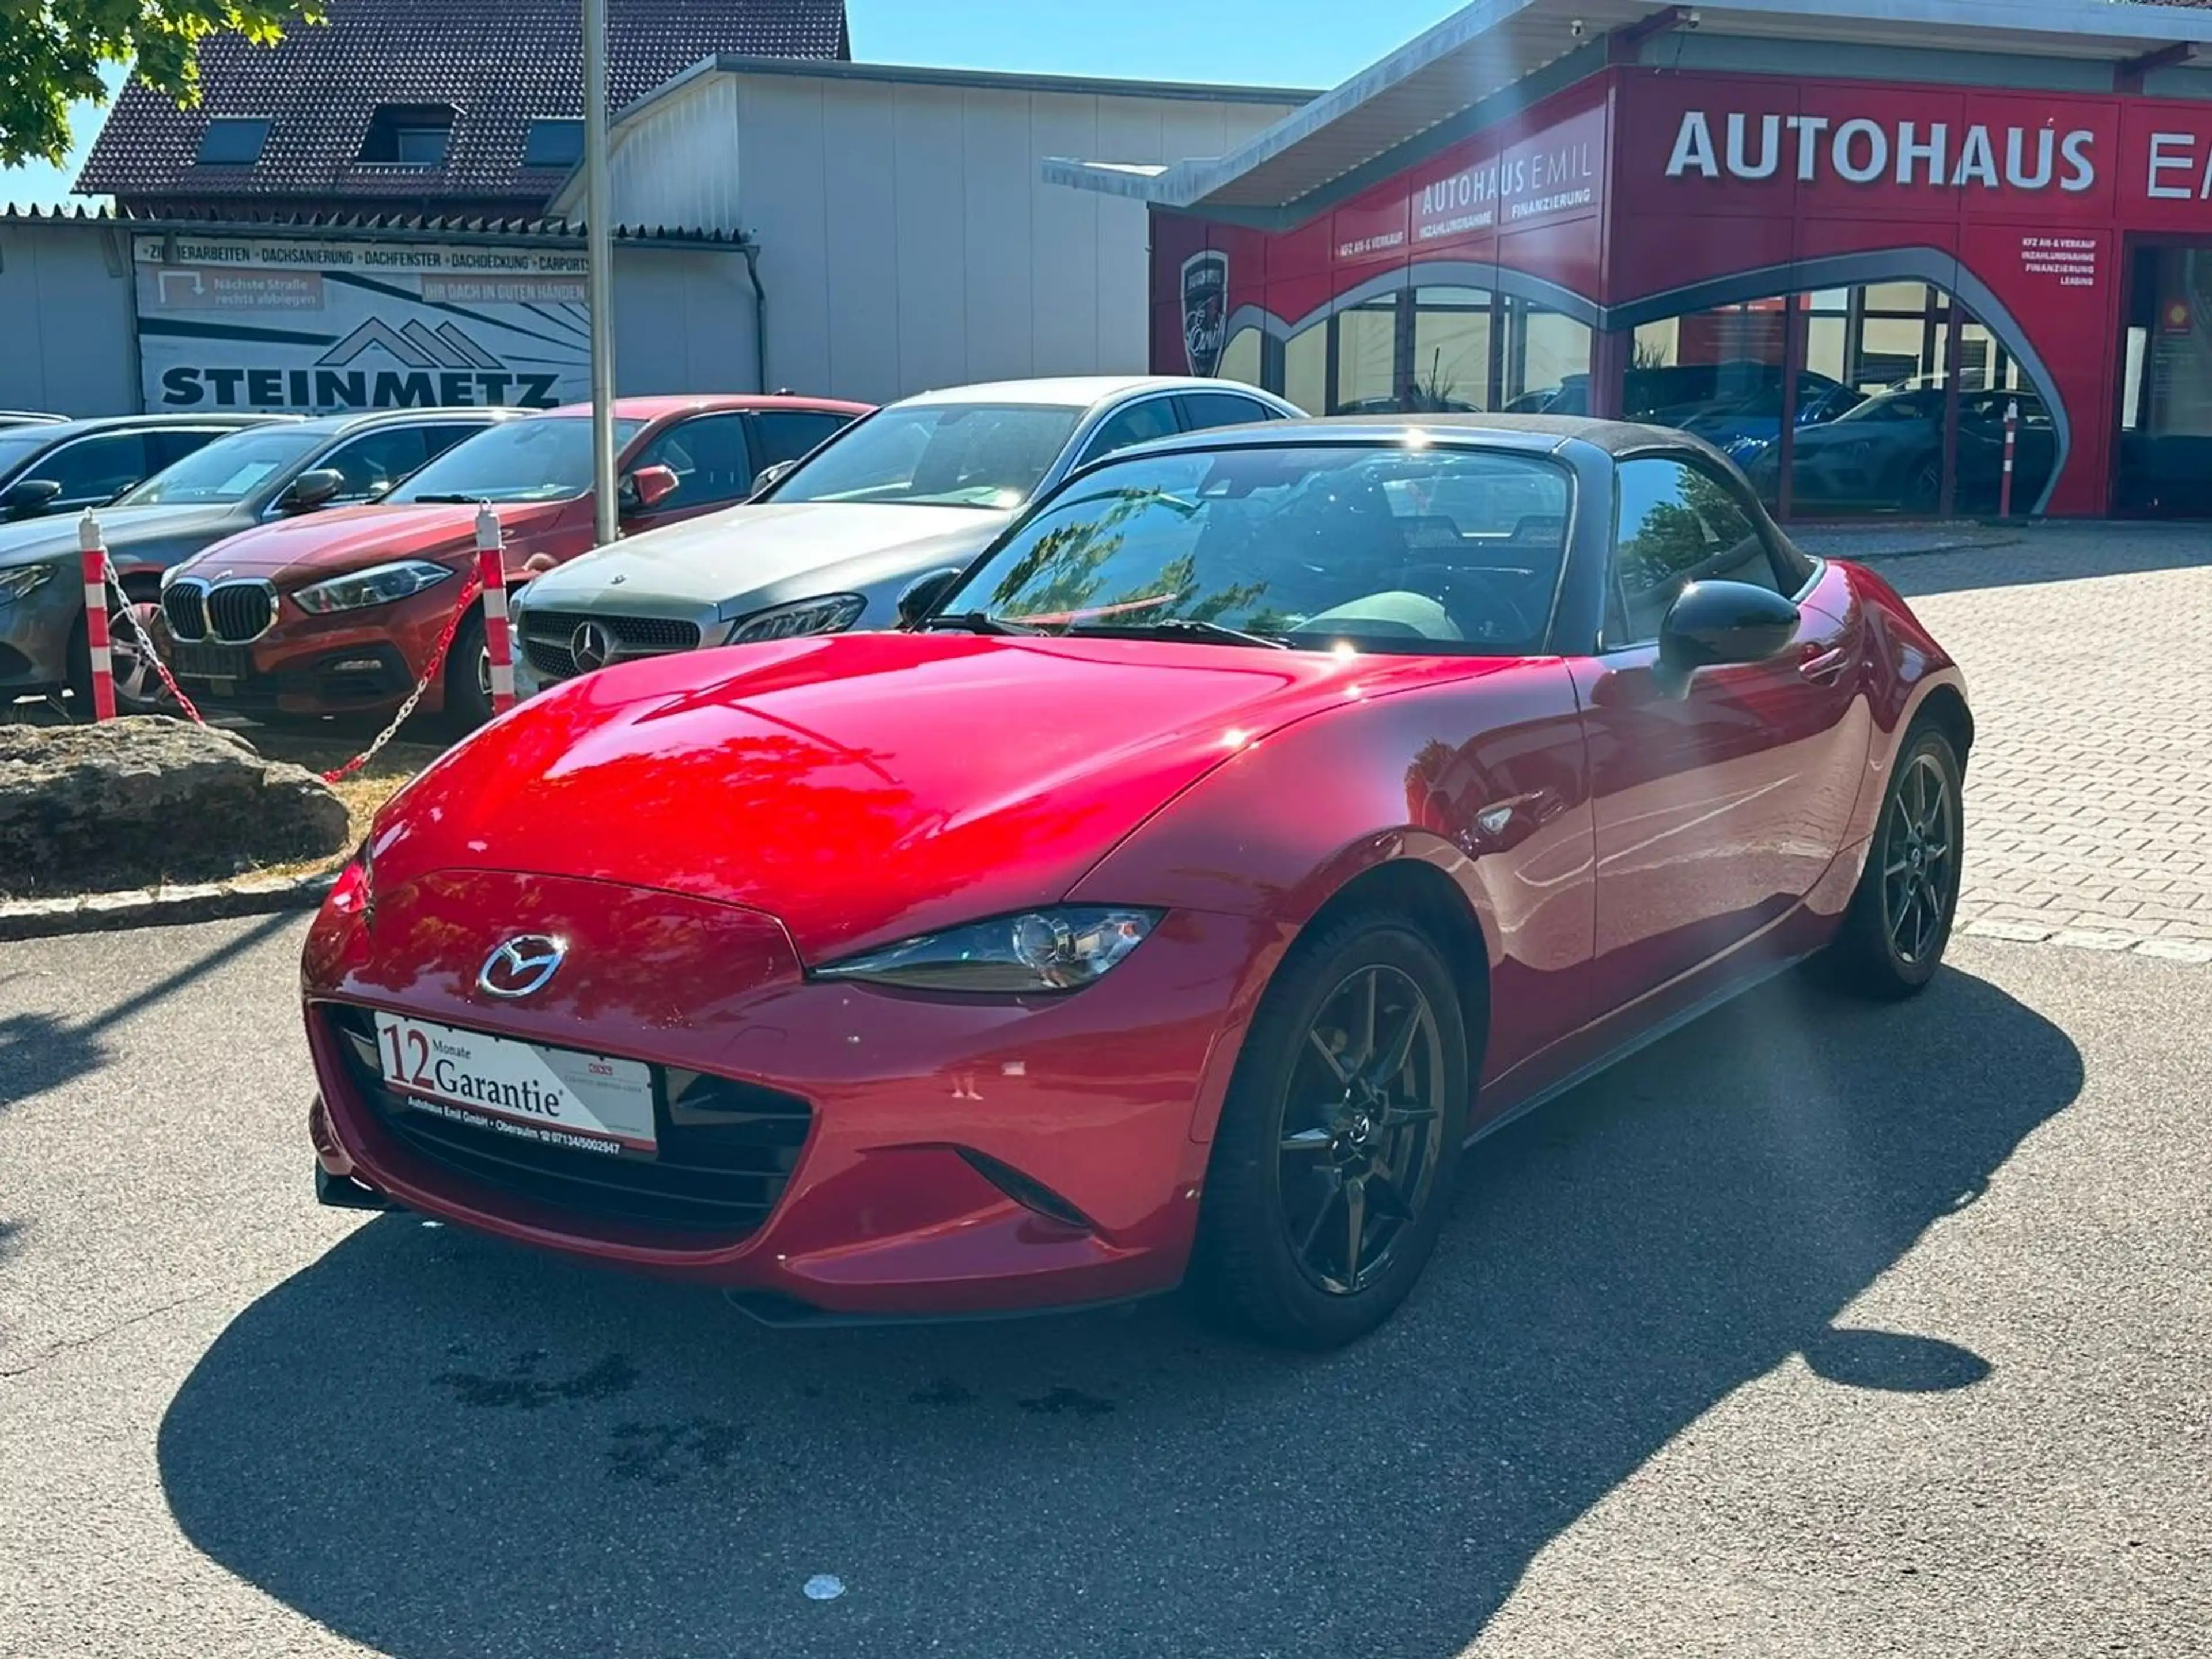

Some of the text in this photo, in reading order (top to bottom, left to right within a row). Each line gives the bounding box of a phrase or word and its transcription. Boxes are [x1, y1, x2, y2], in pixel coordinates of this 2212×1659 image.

[1664, 111, 2212, 199] AUTOHAUS E
[1422, 142, 1592, 215] AUTOHAUS EMIL
[1511, 188, 1591, 219] FINANZIERUNG
[150, 244, 250, 262] ZIERARBEITEN
[262, 250, 353, 264] DACHSANIERUNG
[365, 251, 441, 267] DACHFENSTER
[452, 254, 529, 270] DACHDECKUNG
[2025, 263, 2094, 274] FINANZIERUNG
[214, 279, 308, 291] Nächste Straße
[425, 283, 585, 301] IHR DACH IN GUTEN HÄNDEN
[2060, 276, 2094, 286] LEASING
[215, 293, 316, 308] rechts abbiegen
[162, 366, 560, 408] STEINMETZ
[382, 1024, 434, 1090] 12
[432, 1039, 472, 1060] Monate
